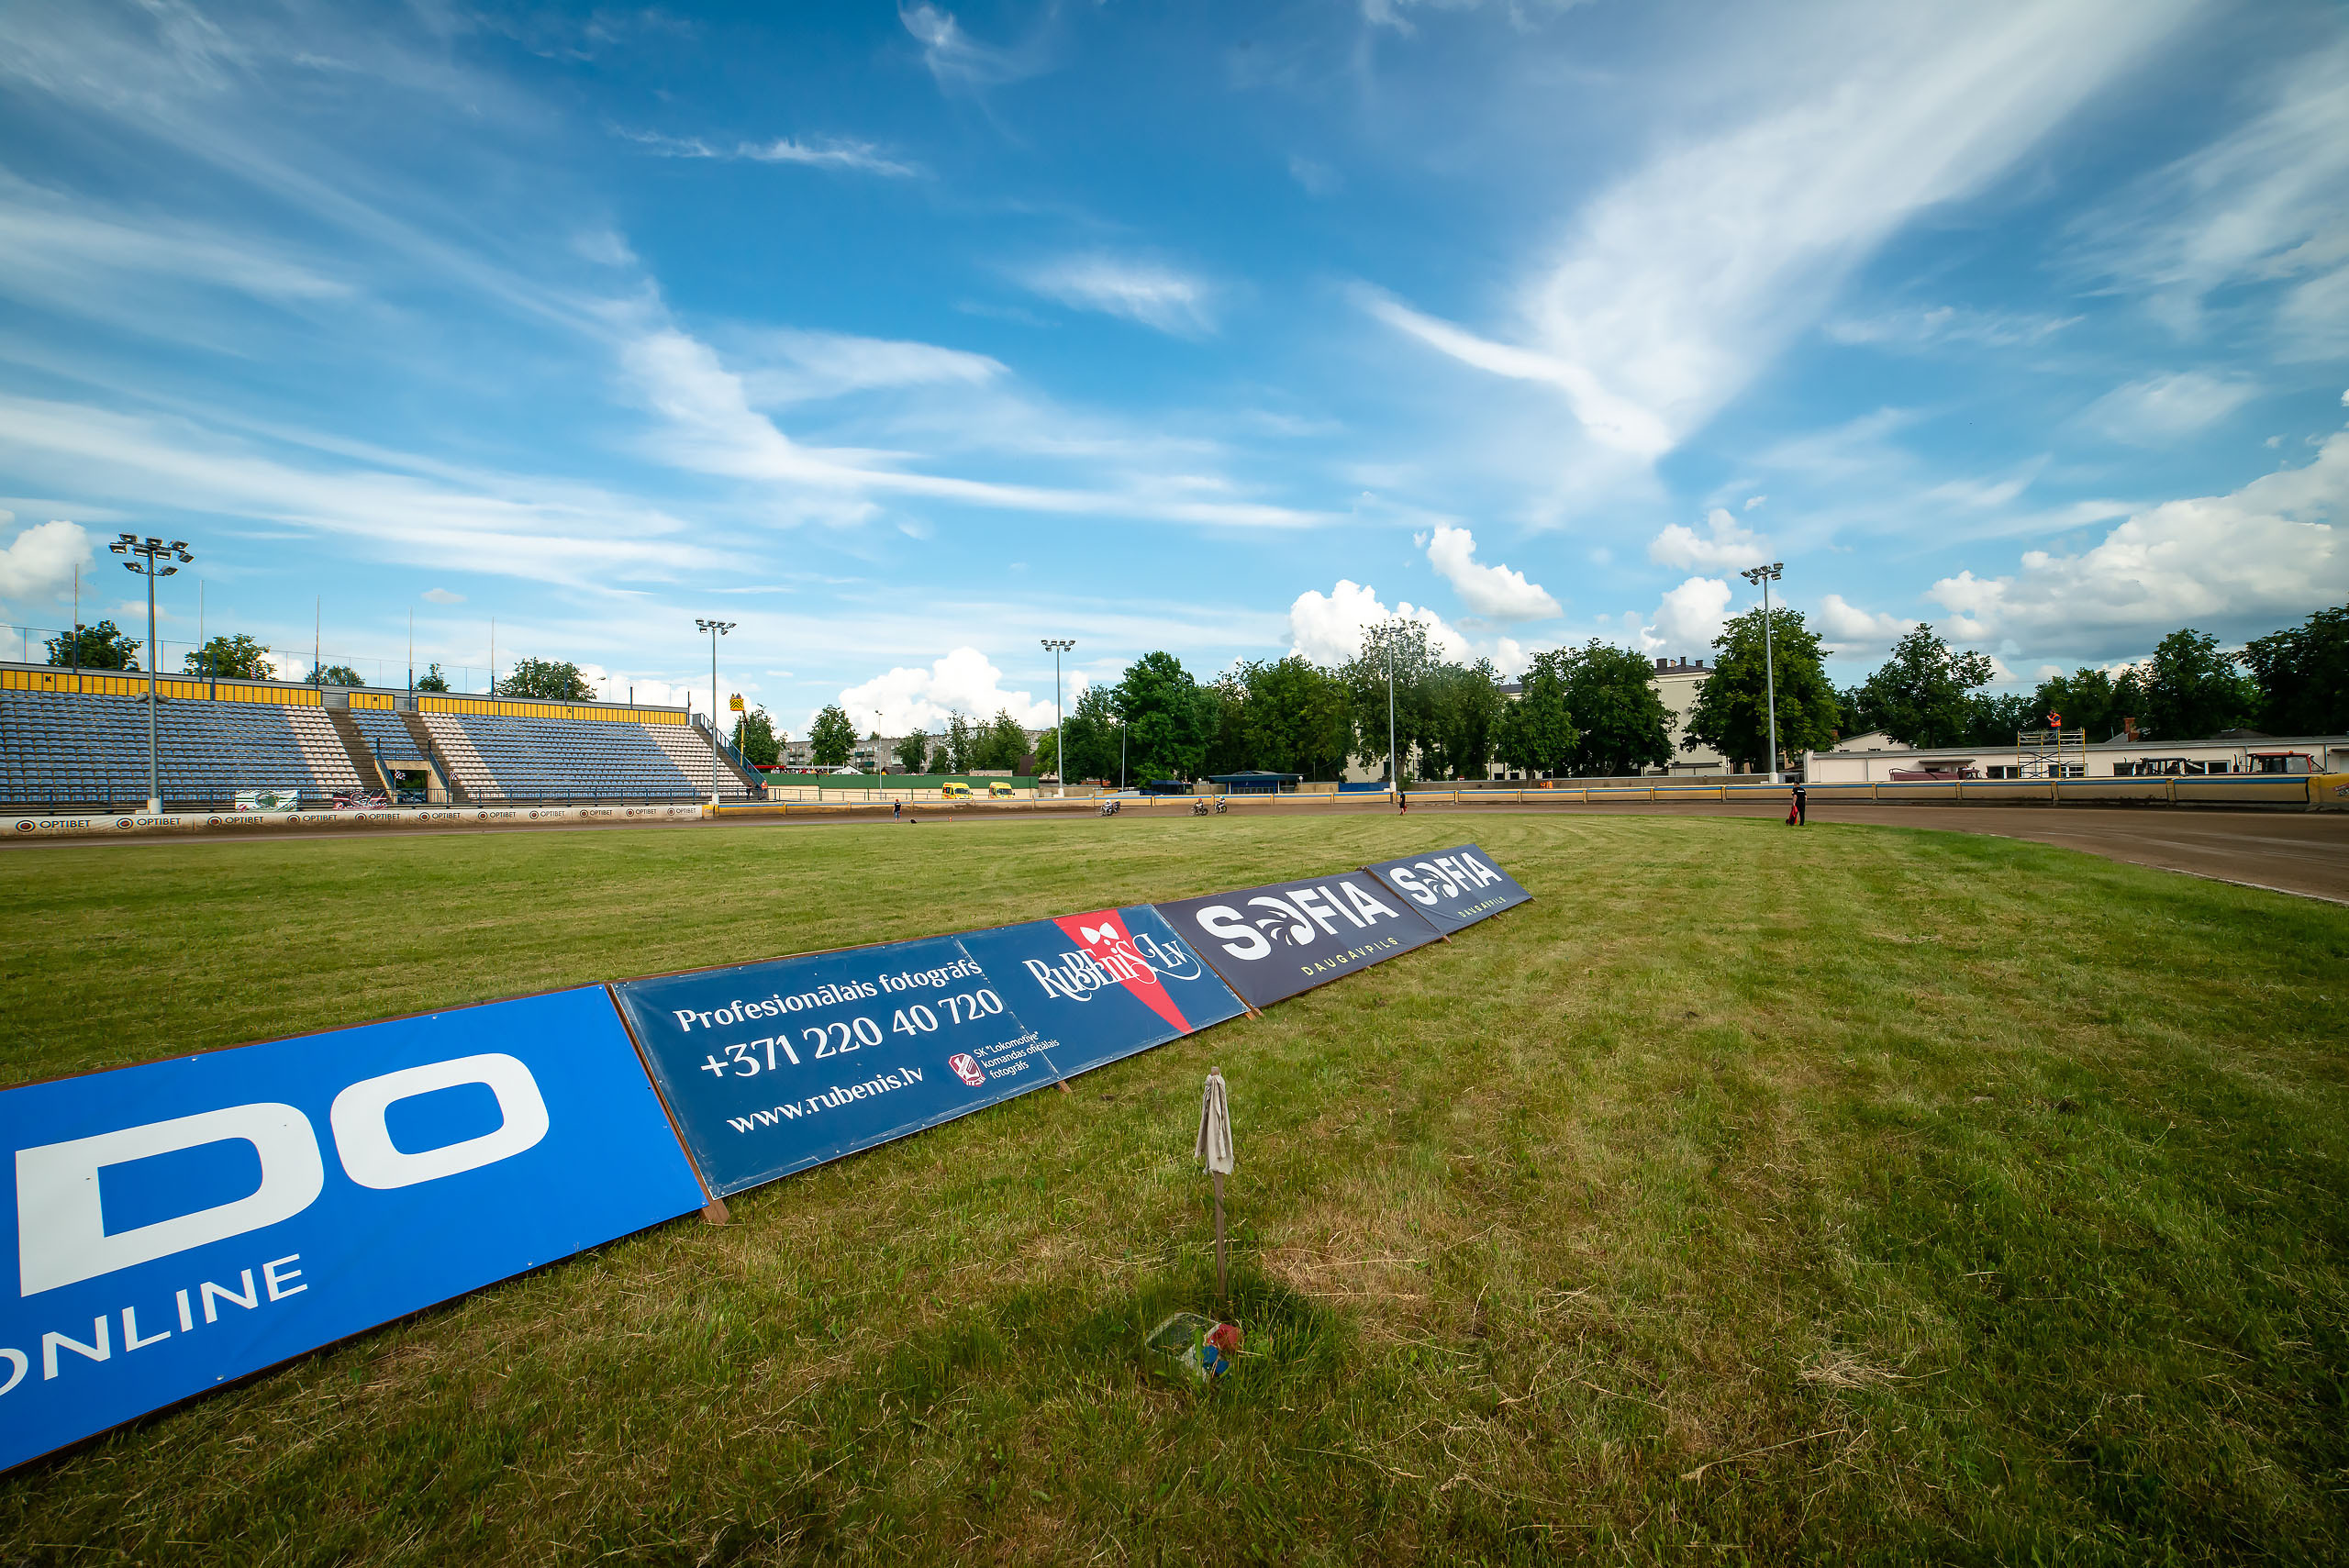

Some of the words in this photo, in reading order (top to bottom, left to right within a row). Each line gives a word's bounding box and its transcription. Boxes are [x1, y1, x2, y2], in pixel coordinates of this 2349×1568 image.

[39, 819, 91, 828] OPTIBET
[136, 817, 182, 826] OPTIBET
[225, 816, 264, 824] OPTIBET
[302, 814, 338, 822] OPTIBET
[1388, 851, 1503, 906] SOFIA
[1457, 895, 1507, 918] DAUGAVPILS
[1196, 881, 1400, 961] SOFIA
[1300, 937, 1398, 976] DAUGAVPILS
[673, 982, 878, 1032] Profesionālais
[878, 960, 983, 989] fotogrāfs
[700, 1033, 801, 1078] +371
[802, 1016, 884, 1060] 220
[892, 1004, 940, 1037] 40
[938, 988, 1005, 1025] 720
[974, 1047, 988, 1058] SK
[981, 1049, 1027, 1069] komandas
[989, 1060, 1029, 1079] fotogrāfs
[726, 1064, 924, 1134] www.rubenis.lv
[15, 1052, 551, 1298] DO
